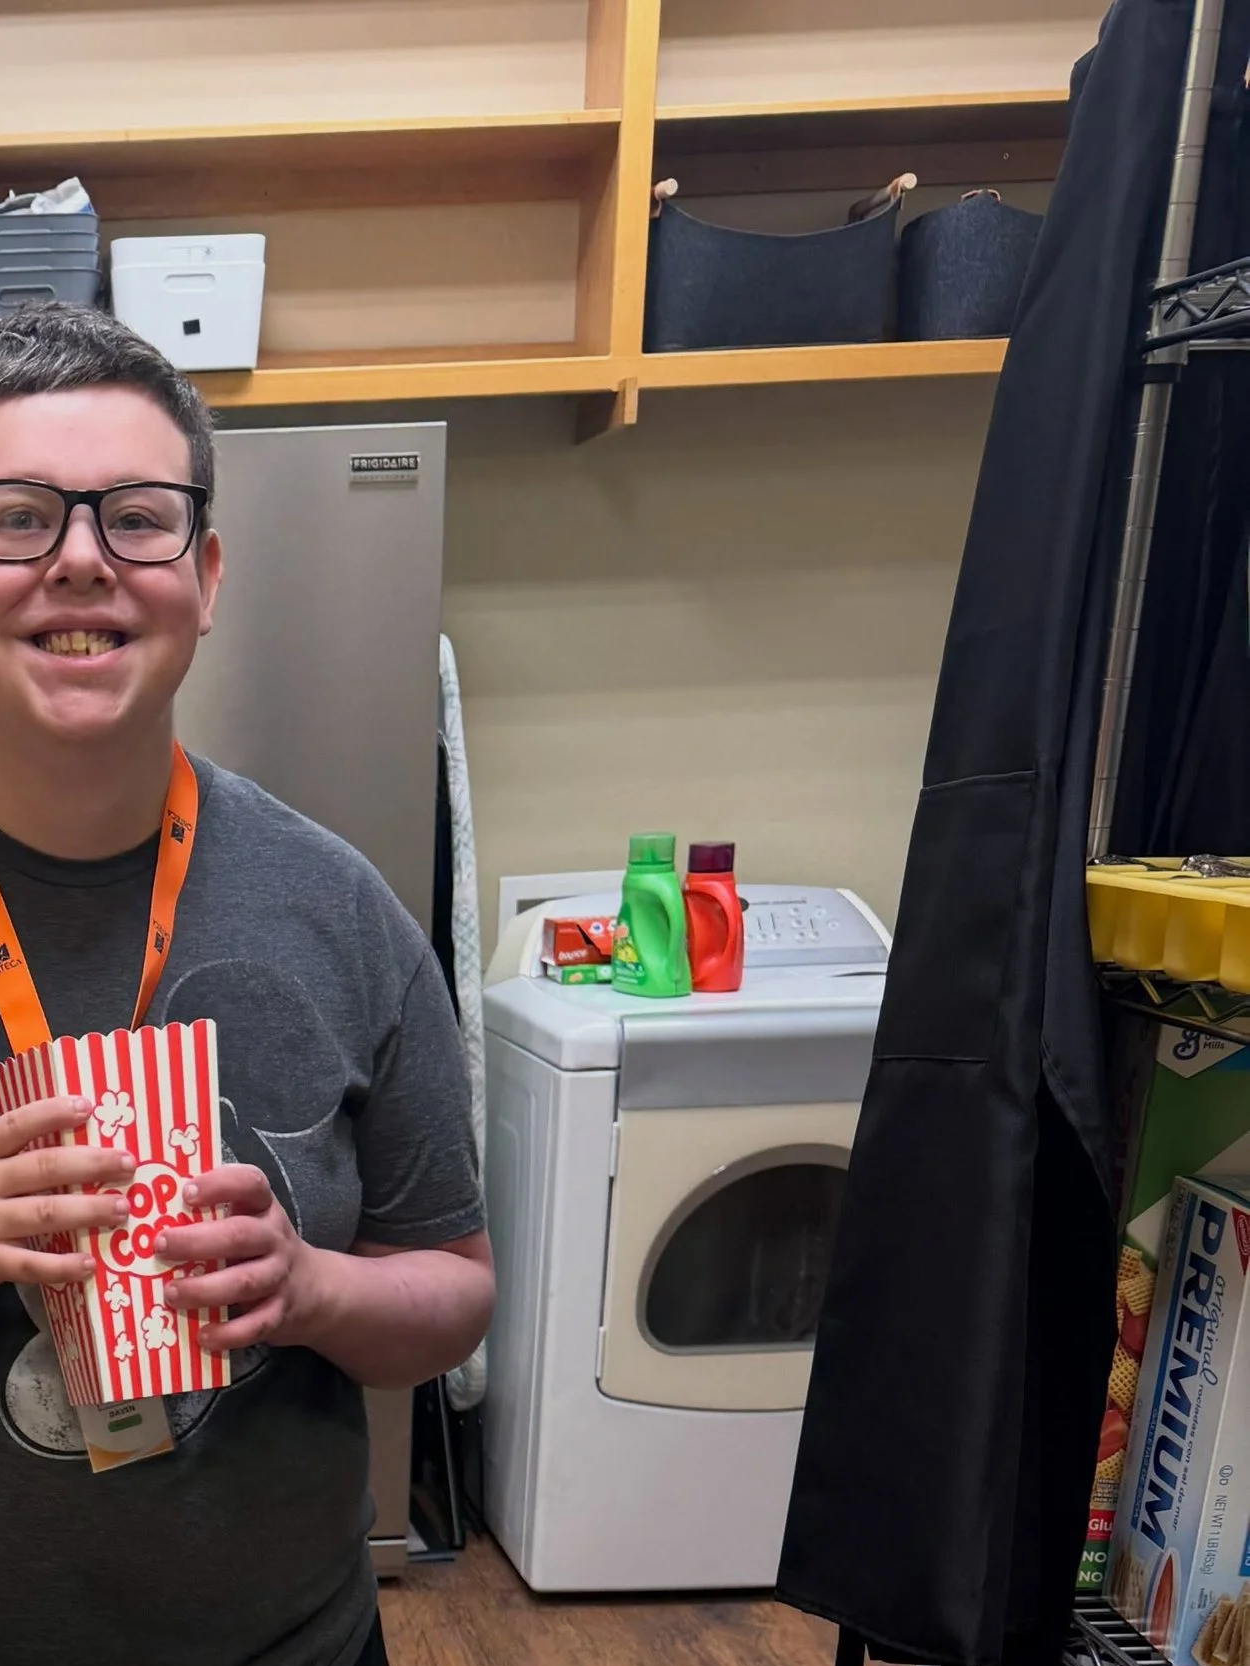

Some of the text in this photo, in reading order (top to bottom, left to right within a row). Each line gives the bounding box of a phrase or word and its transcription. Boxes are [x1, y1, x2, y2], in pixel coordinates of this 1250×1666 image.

[353, 457, 417, 469] FRIGIDAIRE
[102, 1174, 177, 1228] OP
[1200, 1275, 1226, 1386] original
[1141, 1200, 1227, 1550] PREMIUM
[1185, 1440, 1193, 1463] con
[1214, 1494, 1227, 1509] NET
[1088, 1518, 1112, 1531] Glu
[1173, 1504, 1182, 1531] mar
[1212, 1510, 1224, 1530] WT
[1081, 1550, 1107, 1563] NO
[1078, 1571, 1103, 1583] NO
